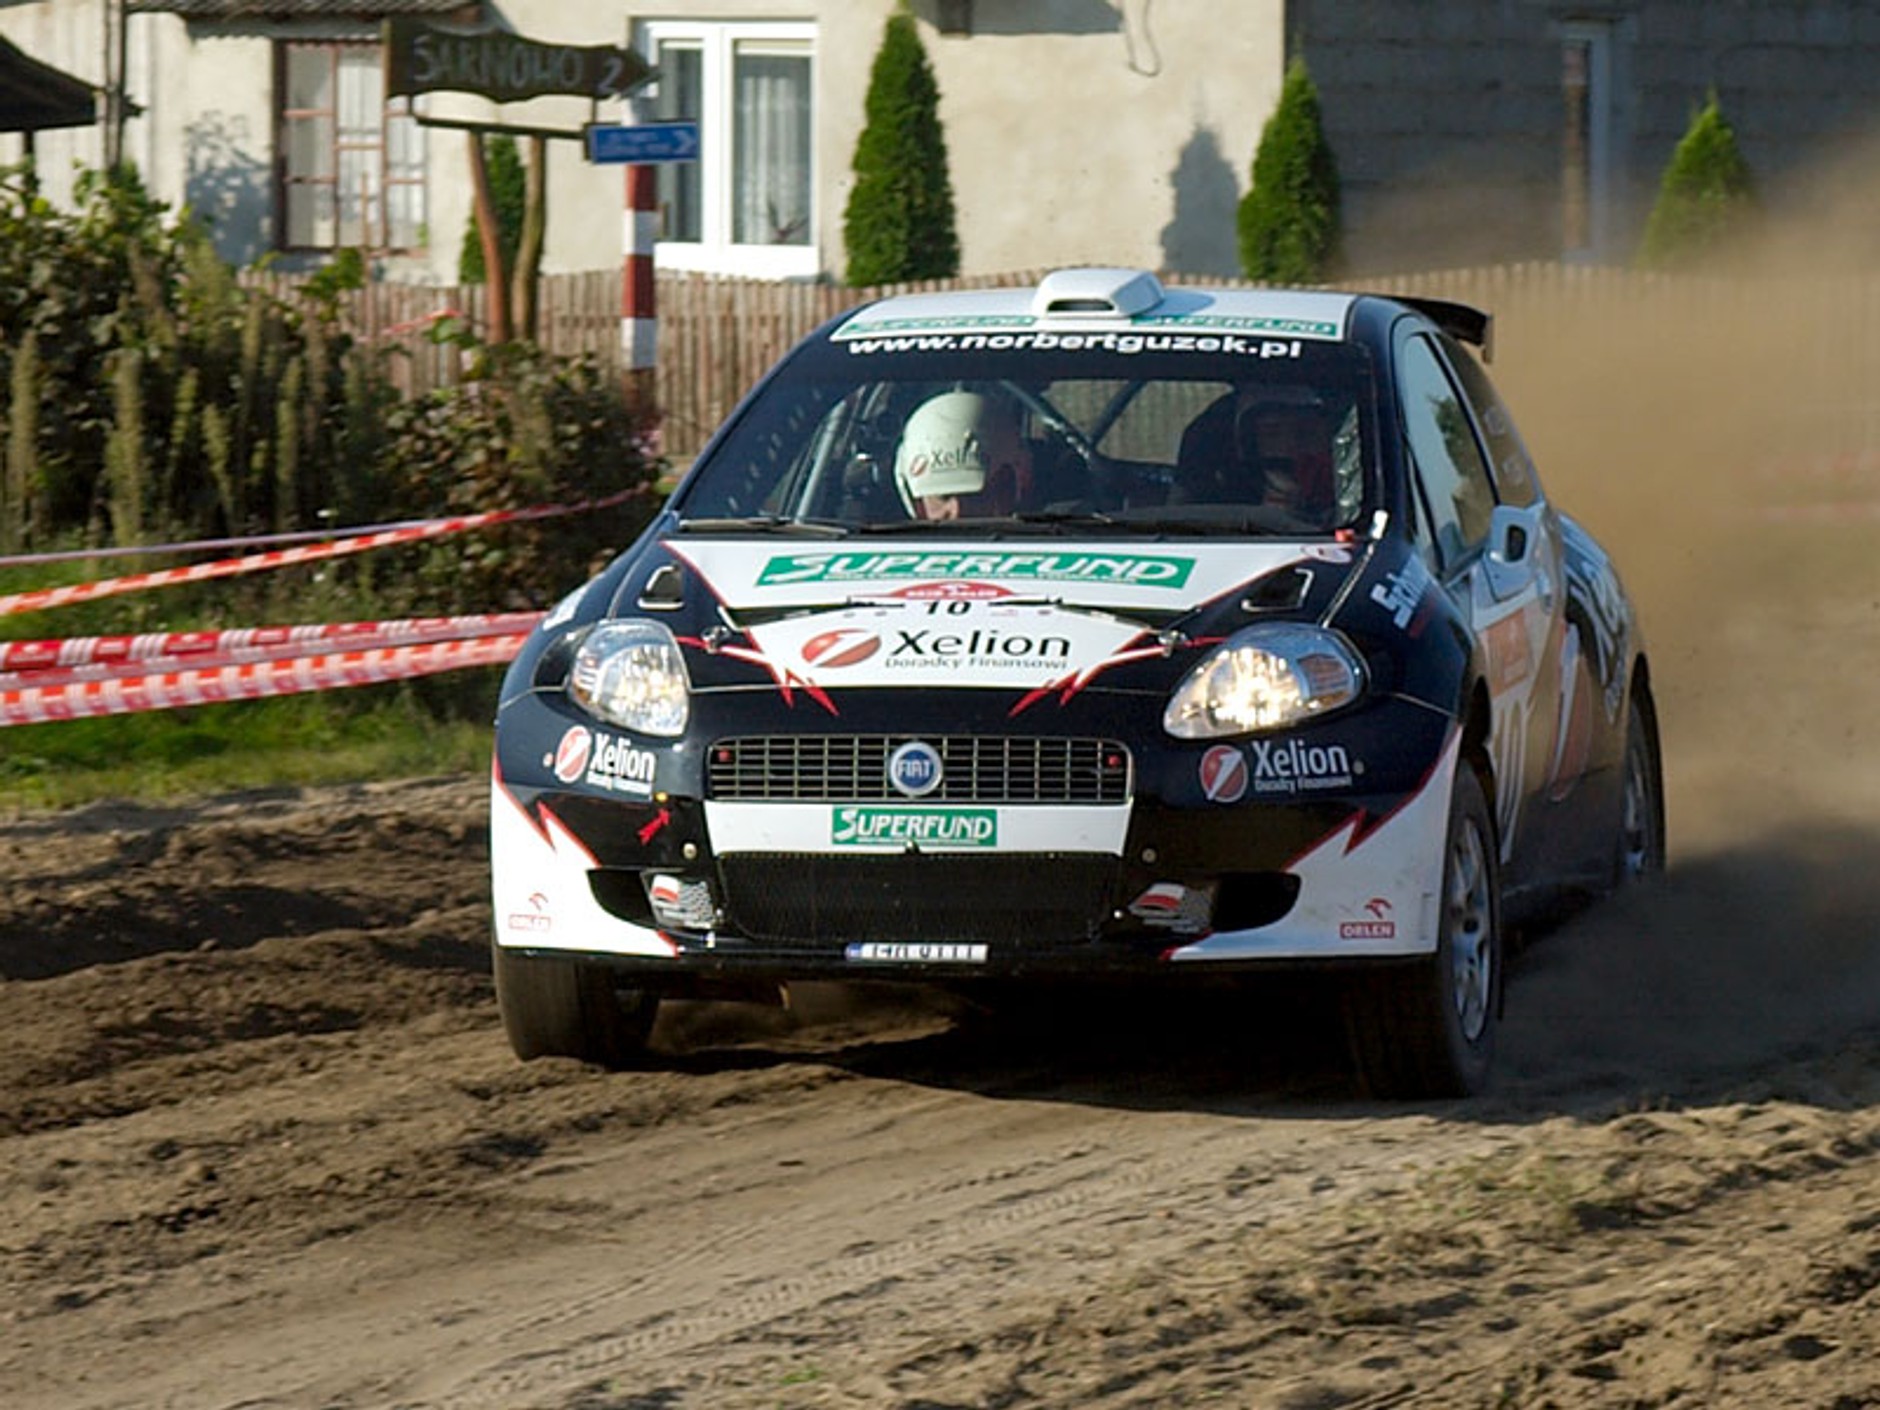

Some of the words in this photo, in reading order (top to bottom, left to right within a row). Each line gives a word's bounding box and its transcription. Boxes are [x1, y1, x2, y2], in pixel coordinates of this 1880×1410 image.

[597, 55, 625, 94] 2
[849, 331, 1302, 358] www.norbertguzek.pl
[763, 553, 1179, 583] SUPERFUND
[891, 630, 1071, 656] Xelion
[590, 732, 655, 782] Xelion
[897, 759, 930, 778] FIAT
[1252, 738, 1350, 777] Xelion
[834, 807, 994, 841] SUPERFUND
[1343, 925, 1392, 938] ORLEN
